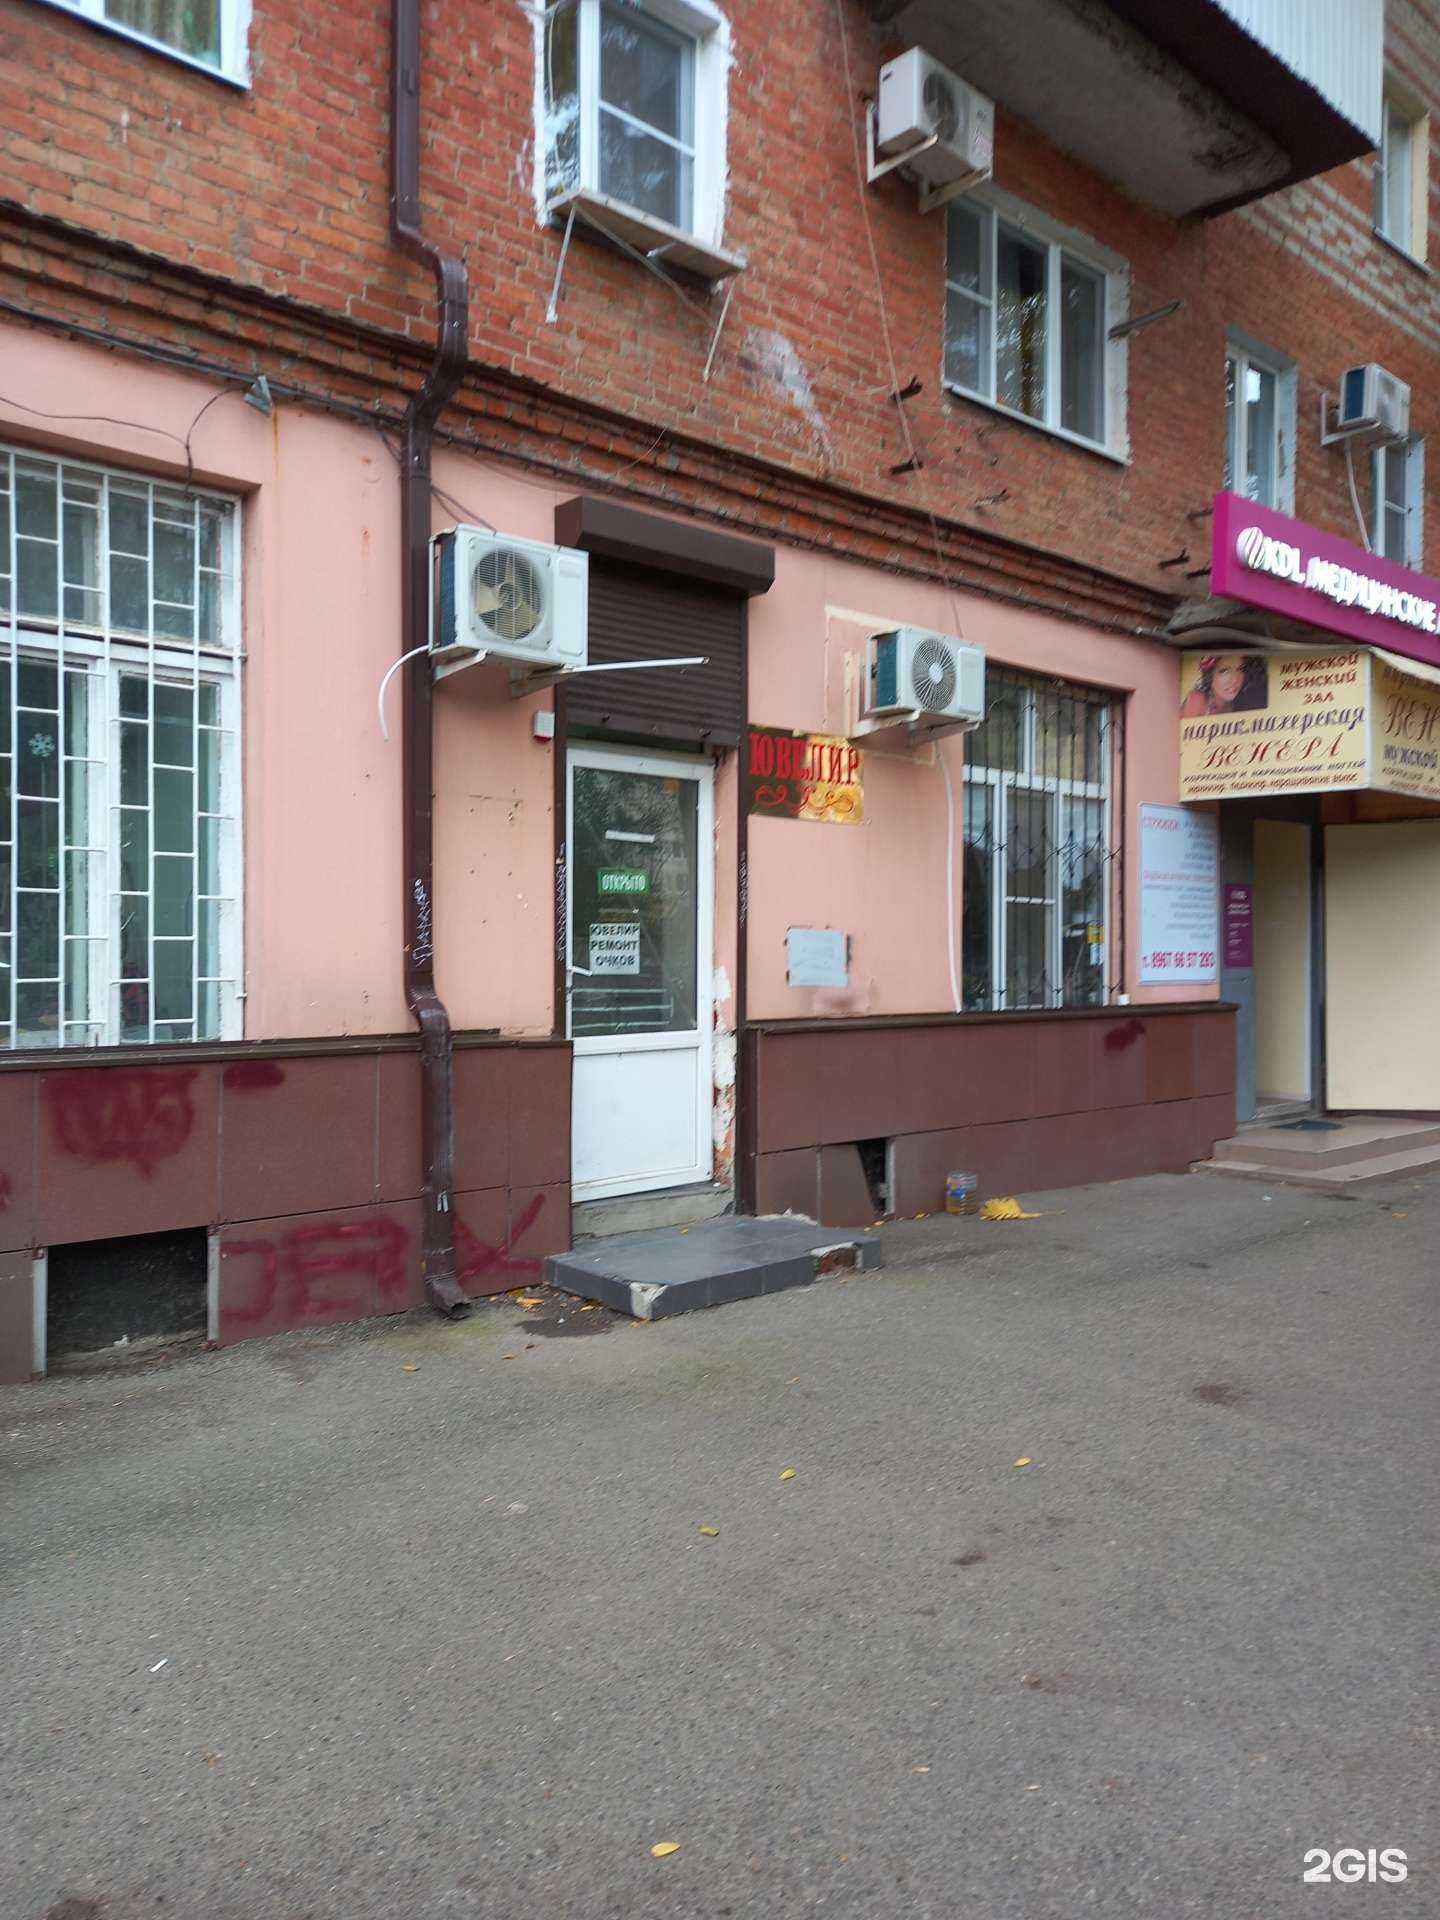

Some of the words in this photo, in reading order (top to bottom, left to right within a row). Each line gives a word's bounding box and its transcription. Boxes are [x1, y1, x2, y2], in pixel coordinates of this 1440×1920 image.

[1304, 556, 1437, 632] МЕДИЦИНСКИЕ
[1280, 652, 1360, 676] МУЖСКОЙ
[1280, 670, 1357, 691] ЖЕНСКИЙ
[1304, 692, 1334, 704] ЗАЛ
[750, 732, 859, 785] ЮВЕЛИР
[1200, 733, 1344, 770] ВЕНЕРА
[602, 874, 645, 891] ОТКРЫТО
[591, 925, 639, 936] ЮВЕЛИР
[591, 940, 637, 951] РЕМОНТ
[595, 955, 636, 968] ОЧКОВ
